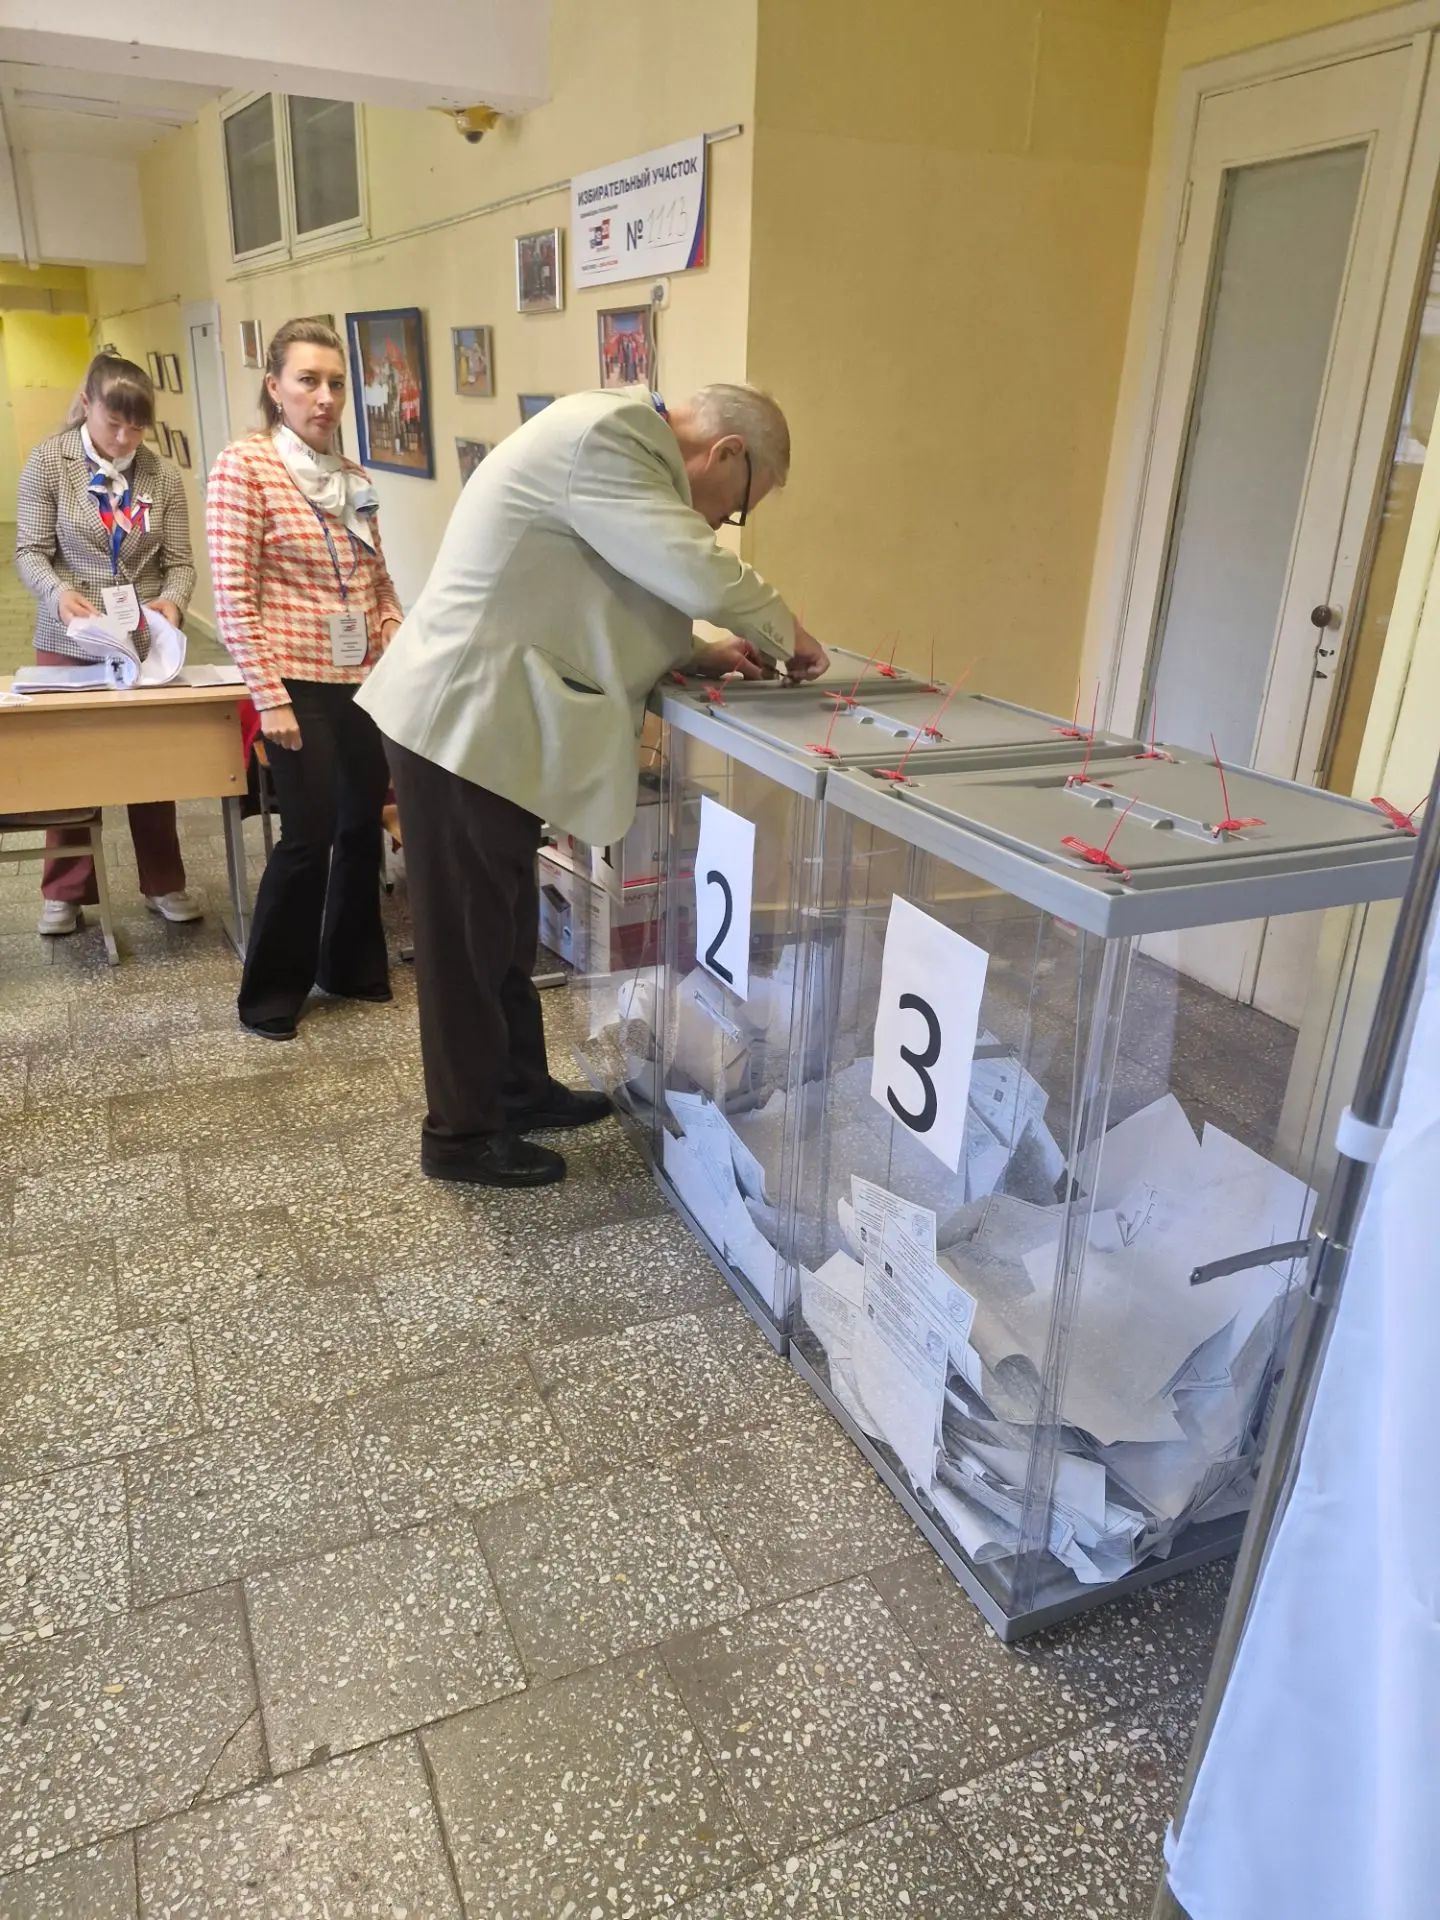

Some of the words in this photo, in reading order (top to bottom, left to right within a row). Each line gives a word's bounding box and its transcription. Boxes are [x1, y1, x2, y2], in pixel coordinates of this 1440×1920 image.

[578, 167, 651, 206] ИЗБИРАТЕЛЬНЫЙ
[651, 156, 698, 185] УЧАСТОК
[626, 218, 644, 251] №
[705, 869, 734, 985] 2
[887, 992, 942, 1134] 3
